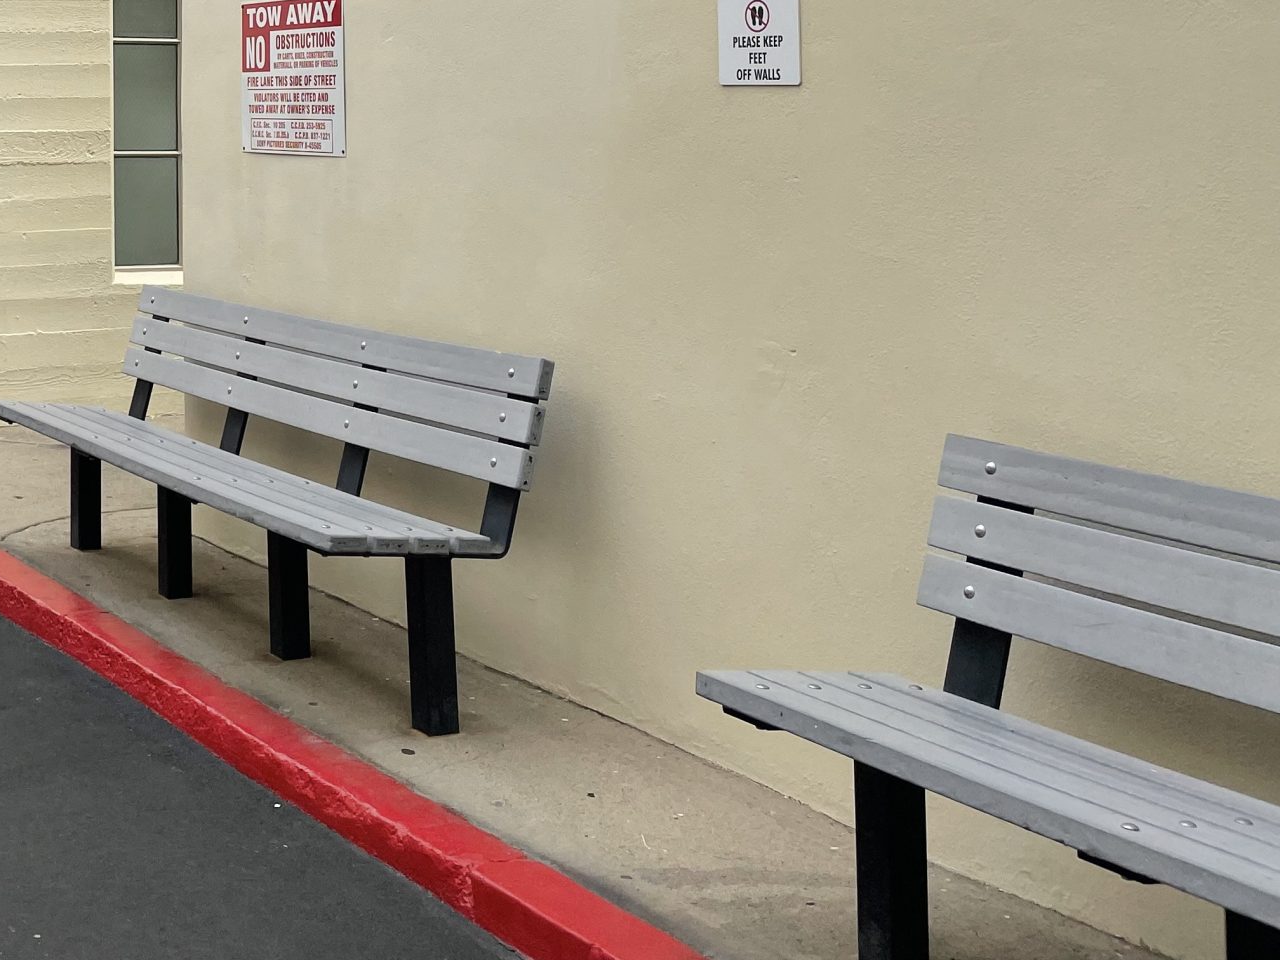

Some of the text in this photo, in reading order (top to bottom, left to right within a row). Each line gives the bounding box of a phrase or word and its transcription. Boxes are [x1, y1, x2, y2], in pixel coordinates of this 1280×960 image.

[247, 0, 336, 29] TOW AWAY
[275, 31, 335, 49] OBSTRUCTIONS
[733, 35, 783, 48] PLEASE KEEP
[245, 35, 265, 69] NO
[749, 52, 767, 64] FEET
[736, 69, 780, 80] OFF WALLS
[247, 75, 336, 87] FIRE LANE THIS SIDE OF STREET
[254, 92, 328, 103] VIOLATORS WILL BE CITED AND
[249, 105, 335, 114] TOWED AWAY AT OWNER'S EXPENSE
